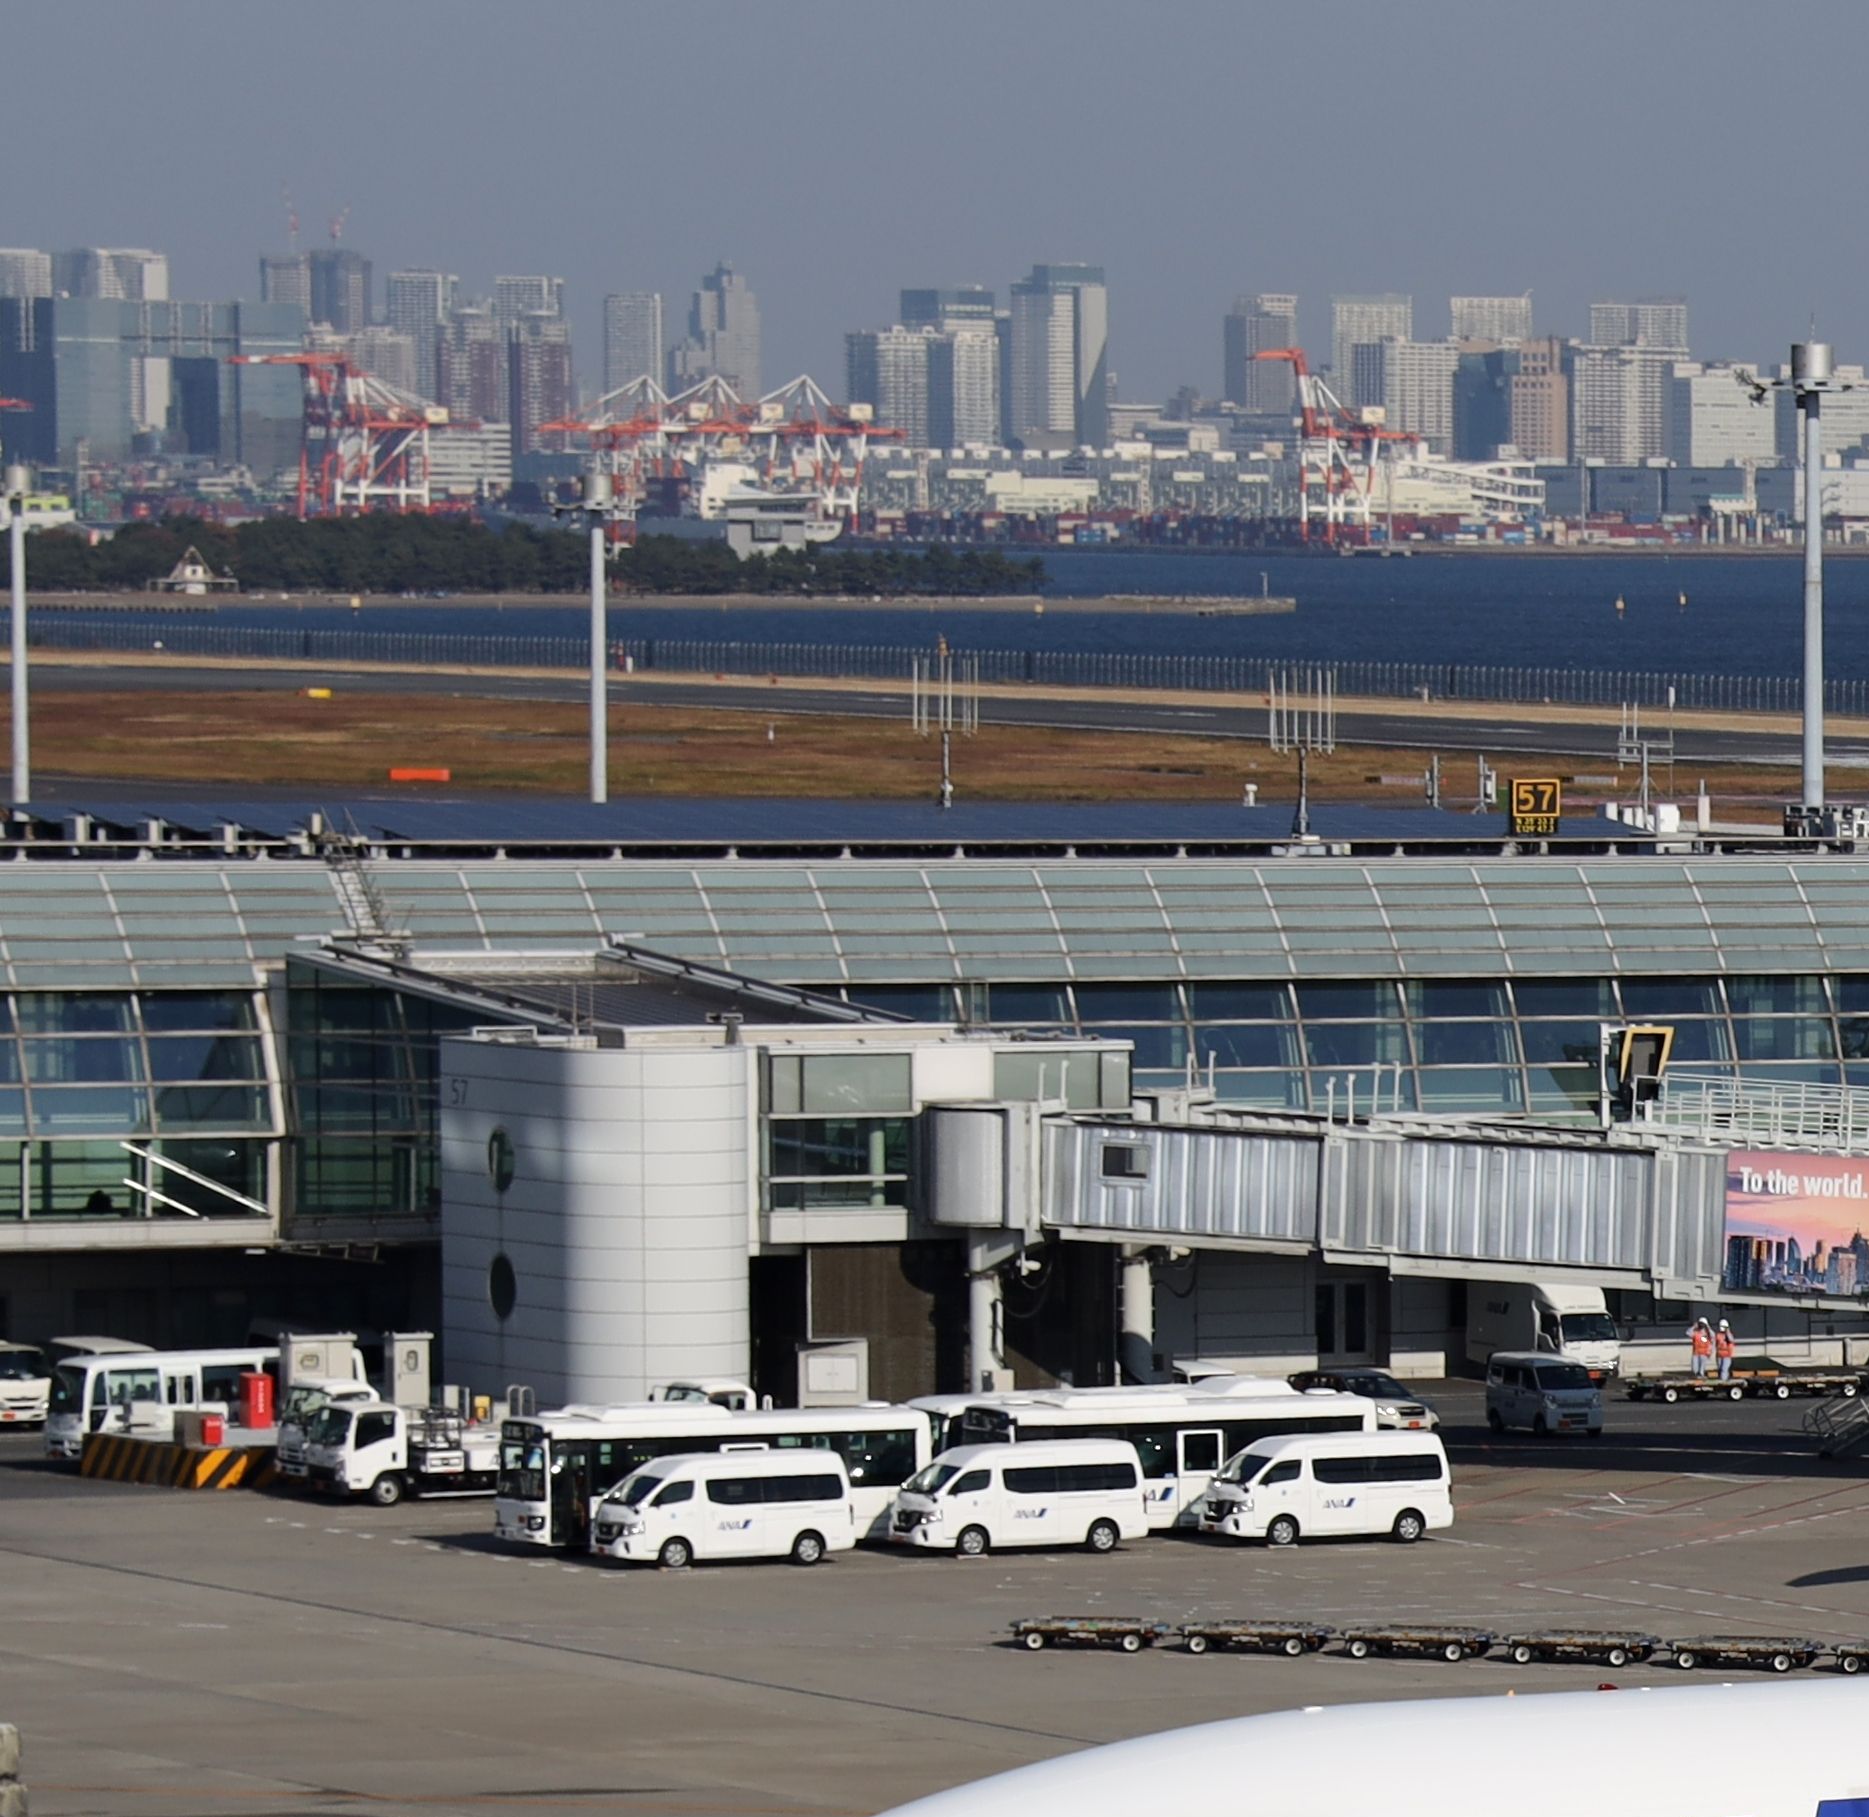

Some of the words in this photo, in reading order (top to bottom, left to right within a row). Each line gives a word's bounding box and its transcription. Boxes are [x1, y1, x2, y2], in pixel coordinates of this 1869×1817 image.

[1519, 785, 1553, 811] 57
[452, 1078, 468, 1105] 57
[1740, 1166, 1762, 1193] To
[1766, 1168, 1798, 1195] the
[1803, 1172, 1868, 1199] world.
